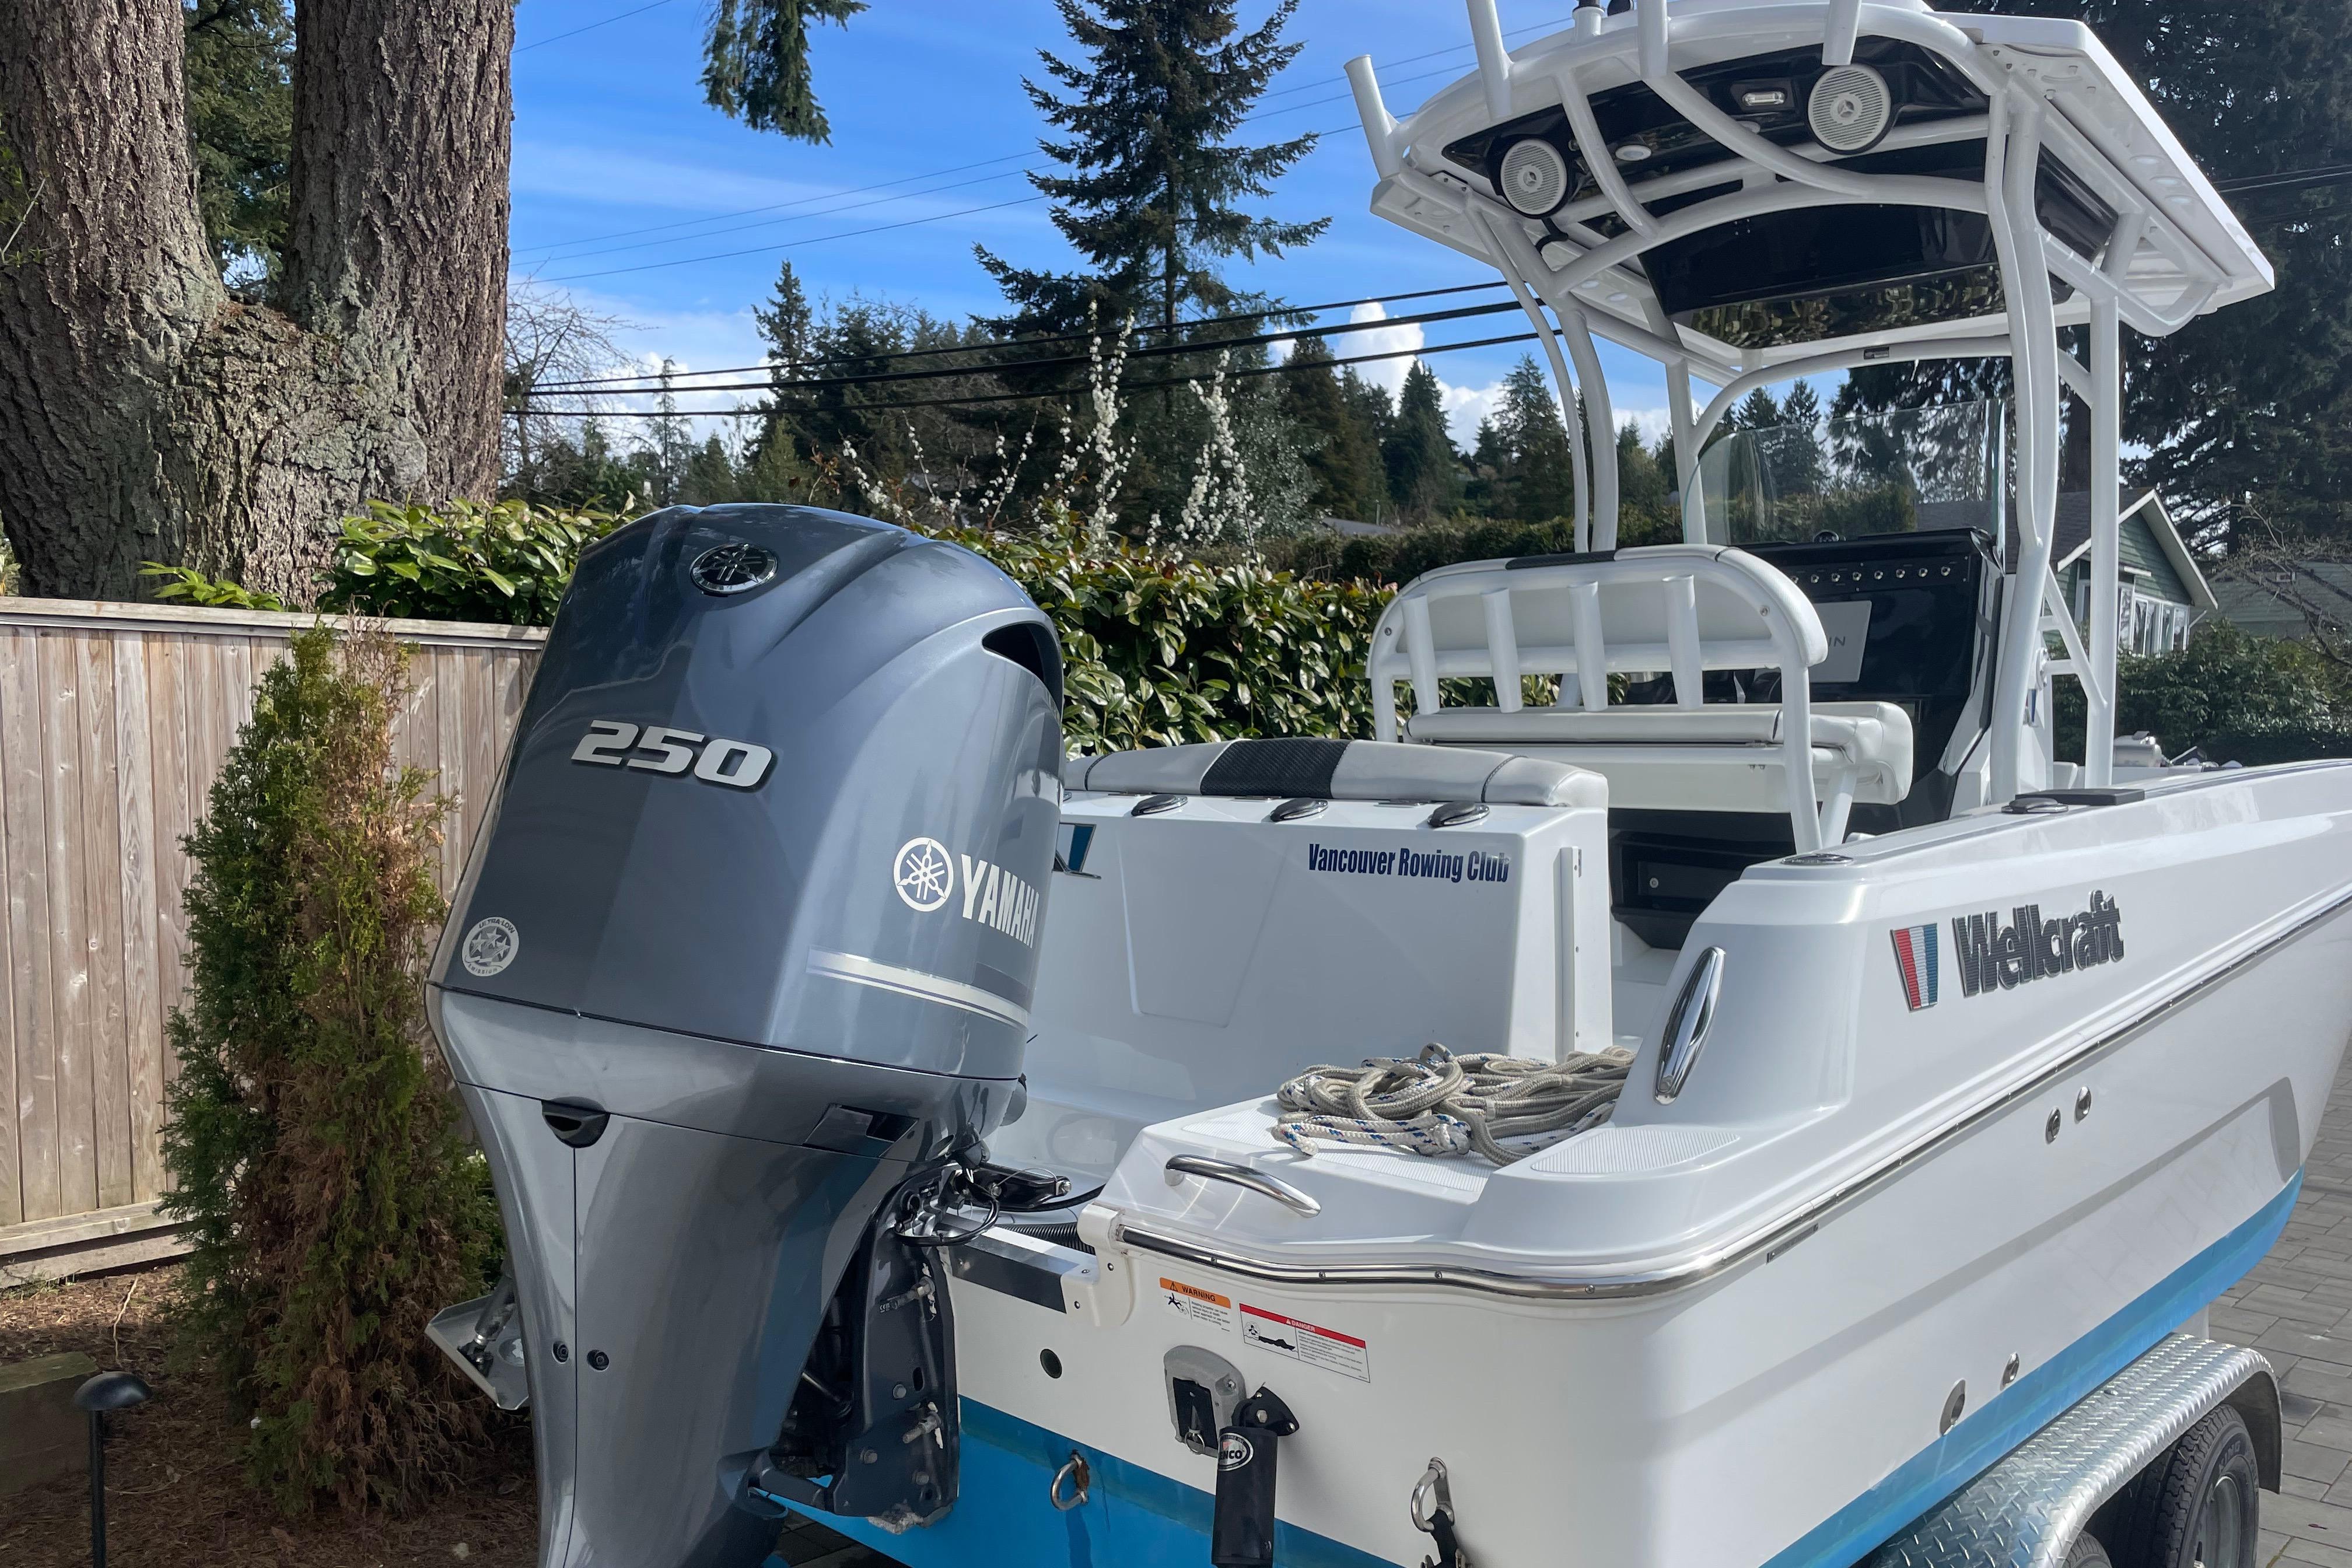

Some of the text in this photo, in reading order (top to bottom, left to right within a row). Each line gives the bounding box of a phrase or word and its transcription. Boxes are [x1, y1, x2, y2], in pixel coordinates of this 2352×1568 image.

[570, 720, 772, 788] 250
[1308, 844, 1510, 883] Vancouver Rowing Club
[961, 853, 1040, 949] YAMAHA
[1951, 889, 2124, 998] Wellcraft
[1181, 1286, 1216, 1301] WARNING
[1291, 1320, 1315, 1332] DANGER
[1219, 1450, 1243, 1460] ENCO
